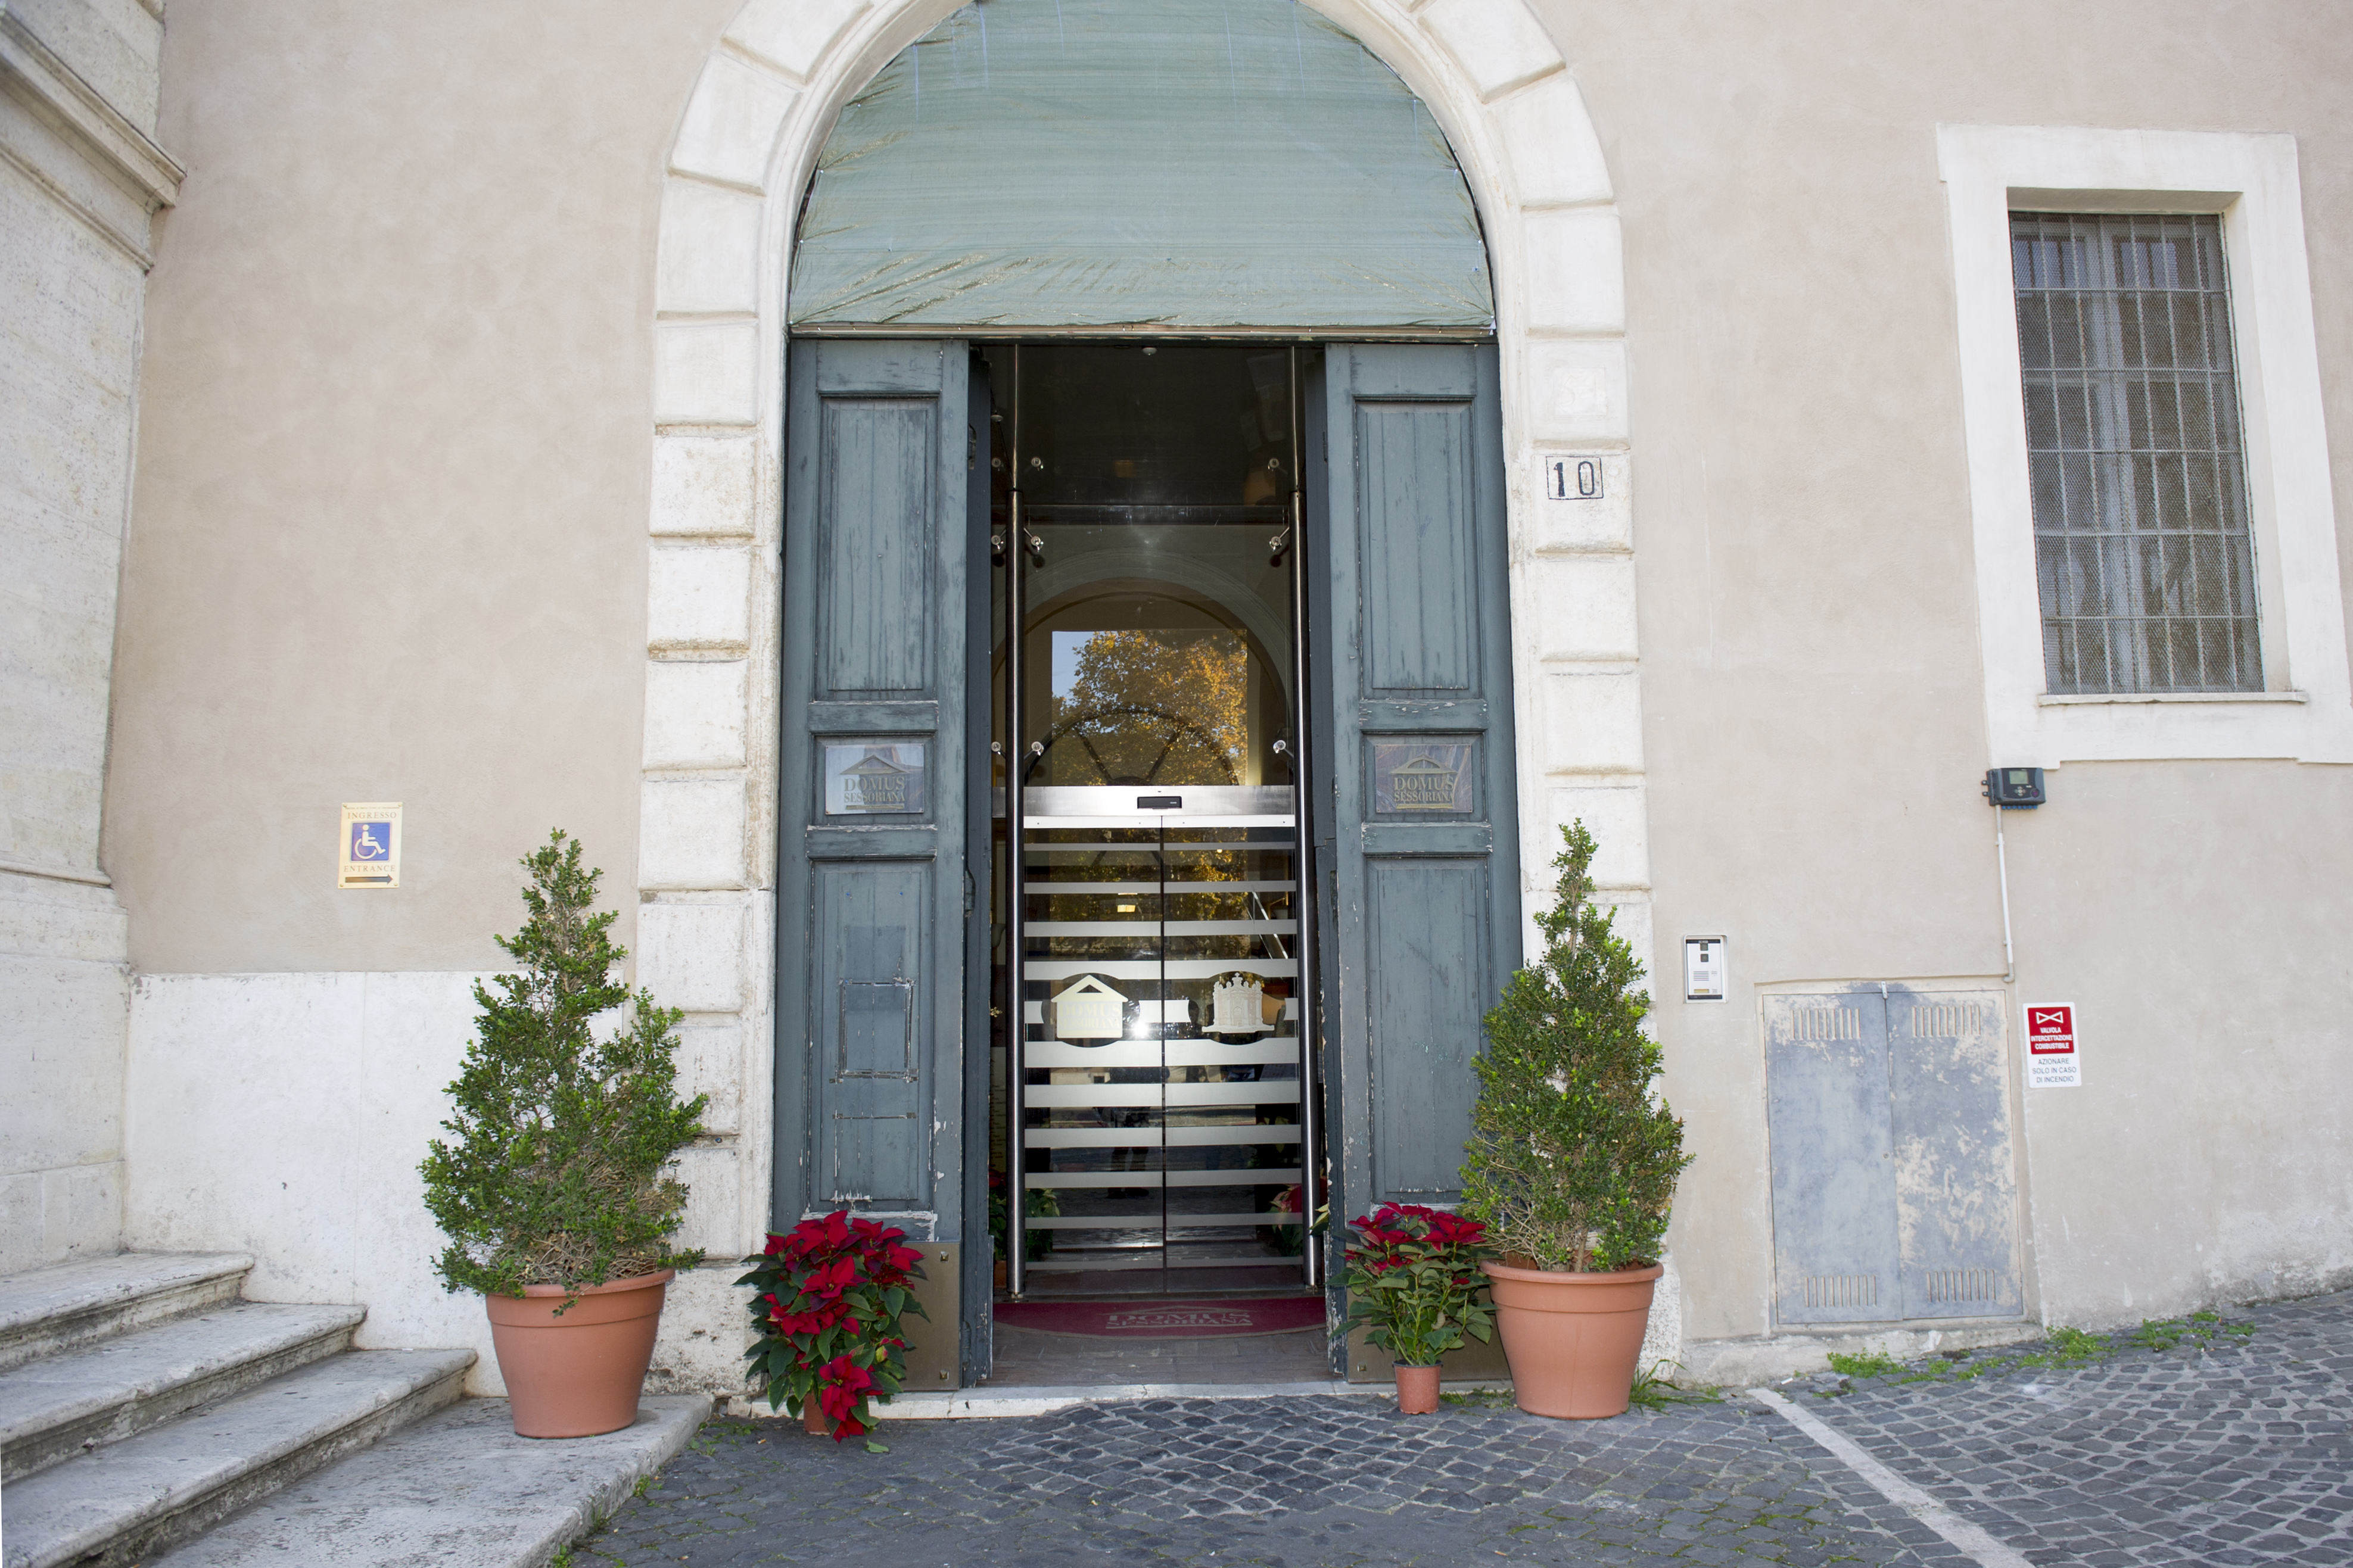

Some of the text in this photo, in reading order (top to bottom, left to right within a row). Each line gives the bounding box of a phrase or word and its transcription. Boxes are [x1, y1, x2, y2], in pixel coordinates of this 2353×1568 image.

[1553, 460, 1595, 497] 10
[844, 776, 905, 791] DOMUS
[1394, 777, 1453, 791] DOMUS
[844, 791, 905, 803] SESSORIANA
[1394, 790, 1454, 802] SESSORIANA
[1059, 1003, 1121, 1017] DOMUS
[1106, 1318, 1253, 1327] SESSORIANA
[1108, 1312, 1250, 1321] DOMUS
